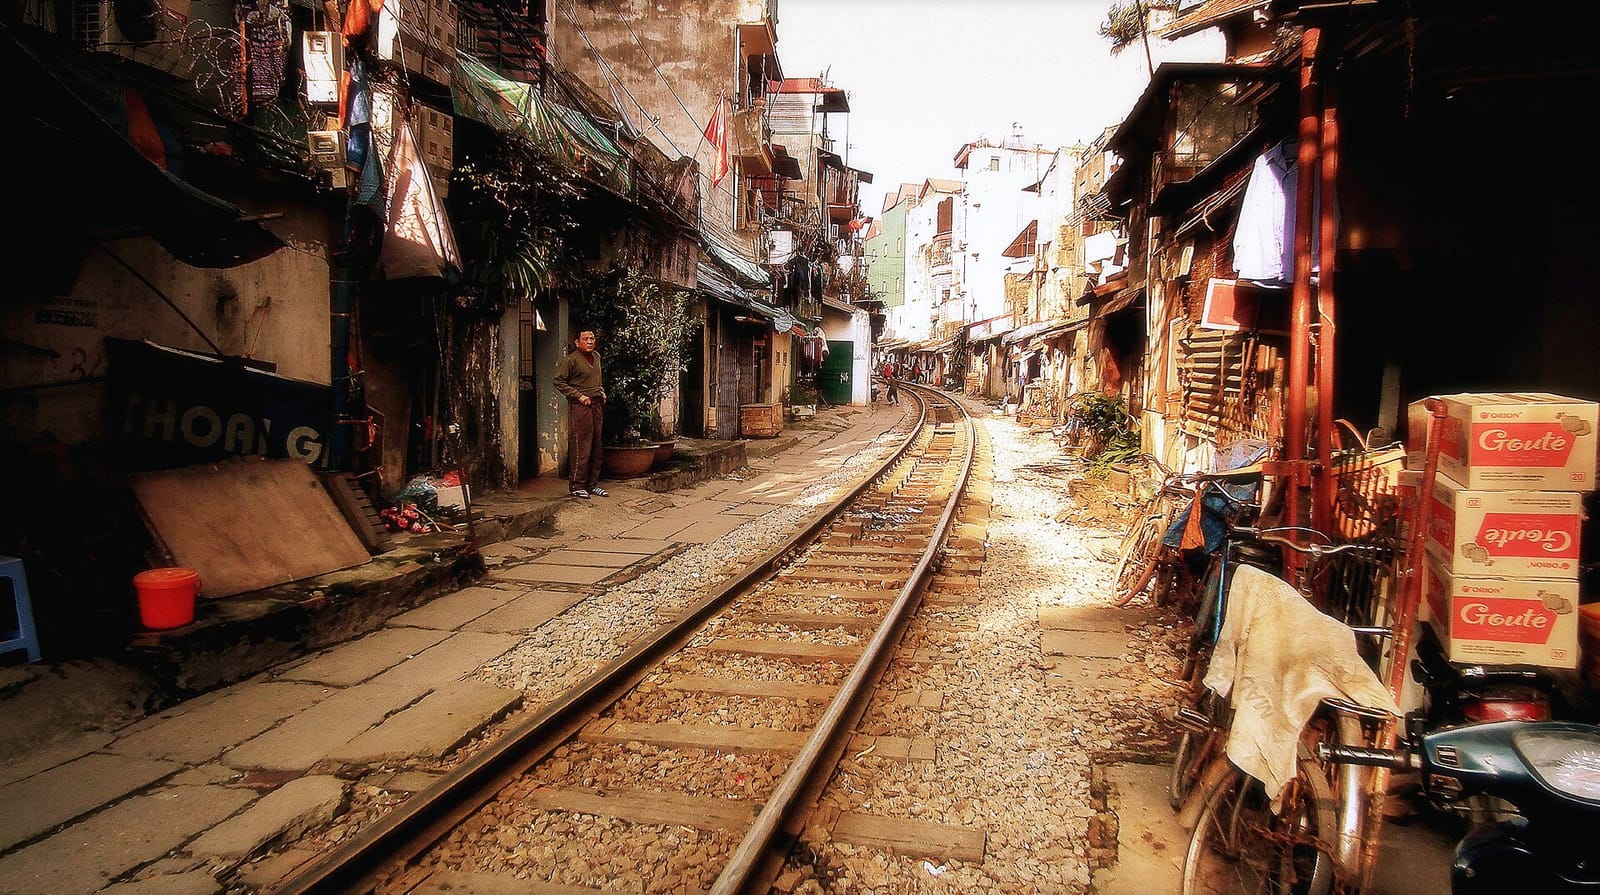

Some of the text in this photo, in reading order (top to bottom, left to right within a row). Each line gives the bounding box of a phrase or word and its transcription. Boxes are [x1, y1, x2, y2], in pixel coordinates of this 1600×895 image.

[1478, 429, 1567, 452] Gouté
[1571, 473, 1583, 481] 20
[1531, 561, 1559, 569] ORION
[1460, 603, 1548, 628] Gouté
